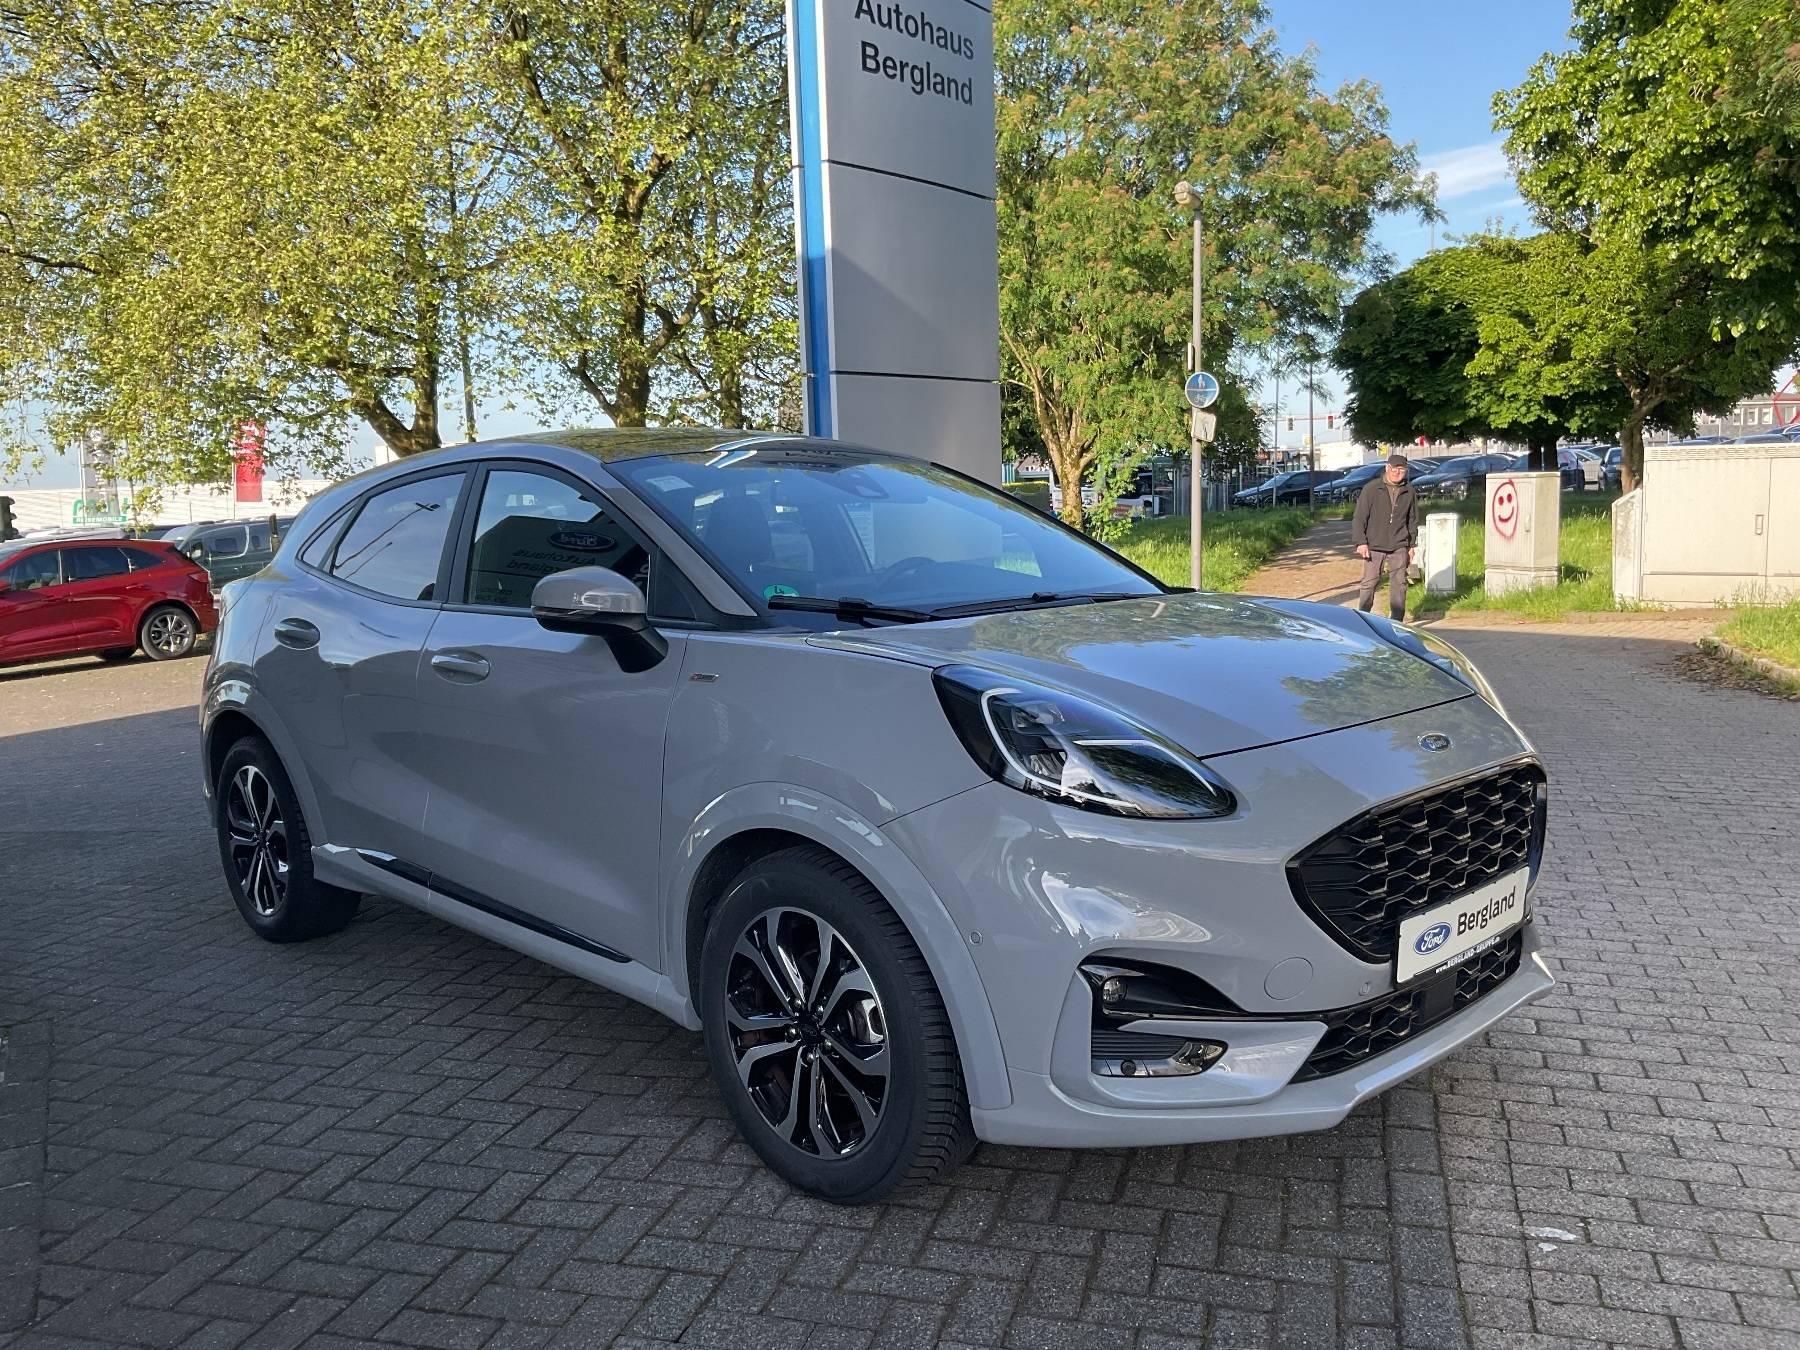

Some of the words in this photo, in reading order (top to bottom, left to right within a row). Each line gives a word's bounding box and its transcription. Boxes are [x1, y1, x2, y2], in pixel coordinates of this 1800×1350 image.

[855, 0, 974, 60] Autohaus
[861, 40, 973, 106] Bergland
[1457, 886, 1516, 936] Bergland
